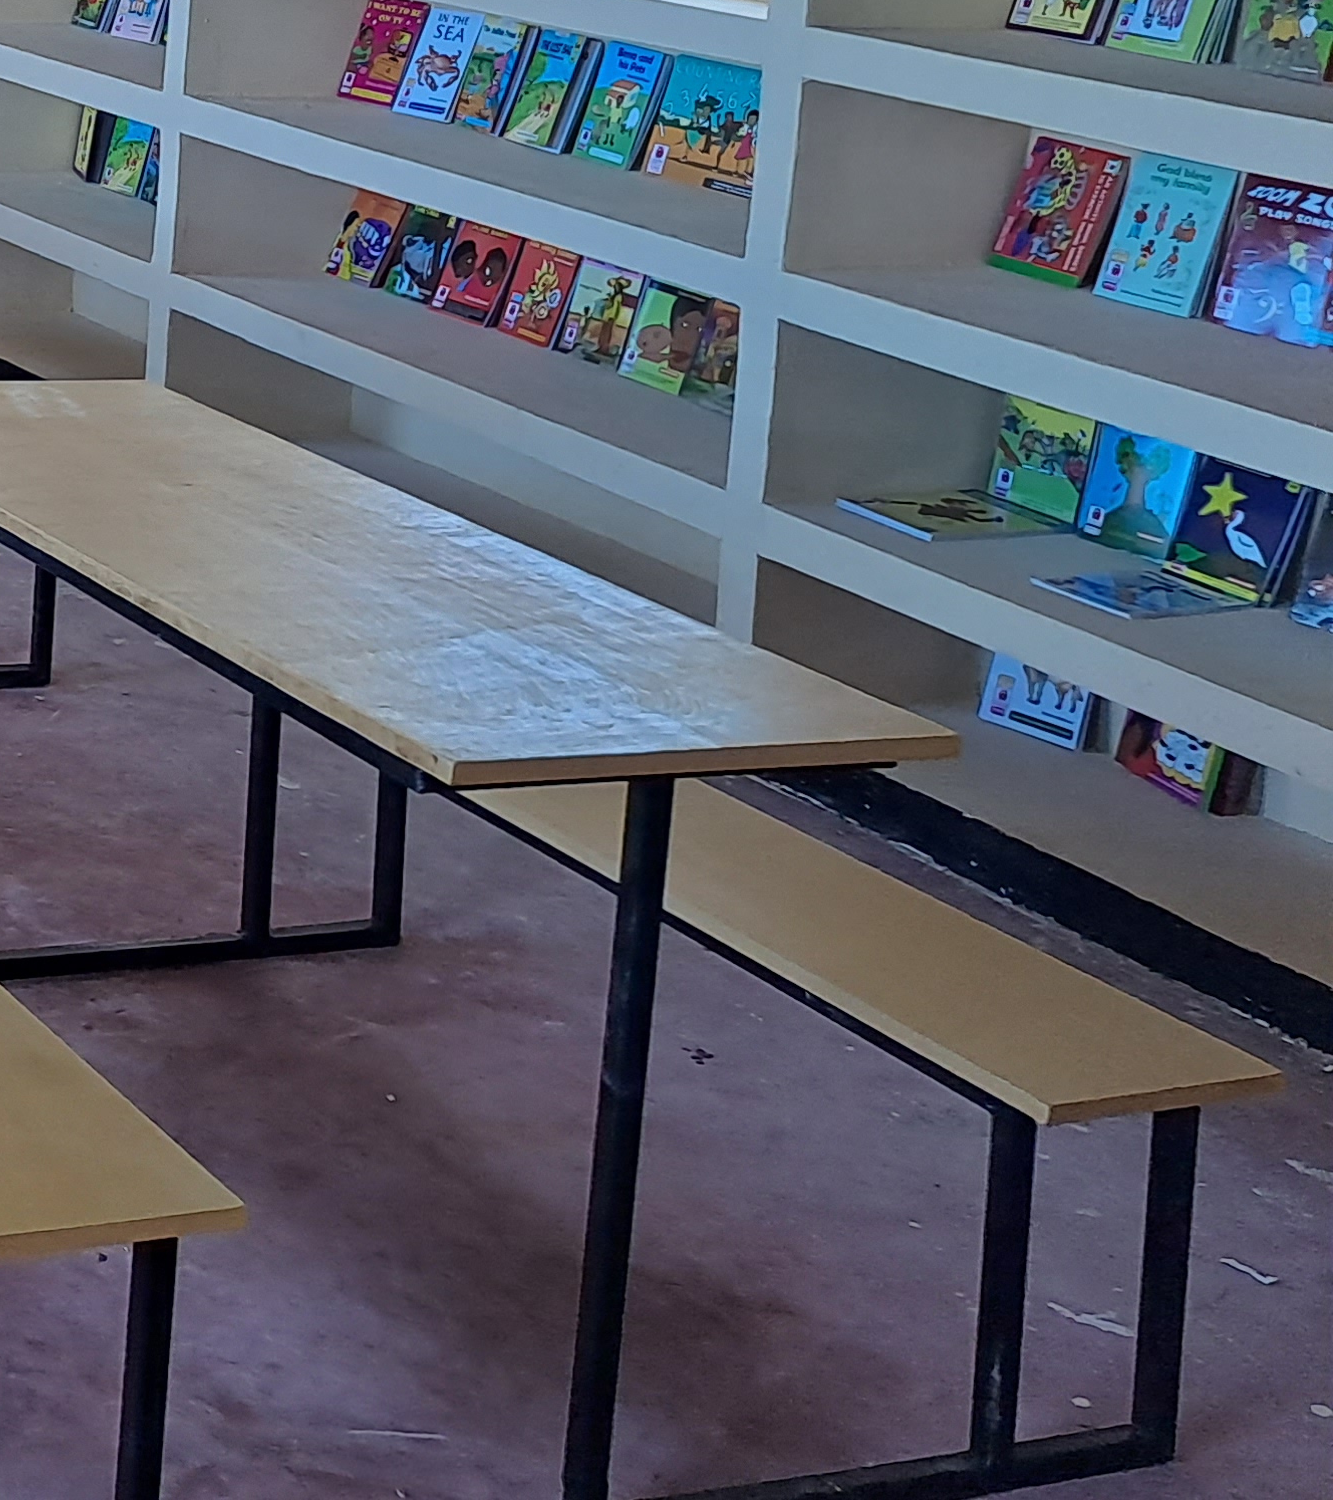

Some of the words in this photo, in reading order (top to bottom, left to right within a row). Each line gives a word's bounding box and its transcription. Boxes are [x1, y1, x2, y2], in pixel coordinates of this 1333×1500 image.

[373, 2, 398, 13] WANT
[398, 6, 410, 15] TO
[438, 13, 450, 23] IN
[452, 15, 470, 26] THE
[433, 23, 465, 43] SEA
[676, 62, 744, 85] COUNTING
[727, 93, 738, 109] 6
[1157, 164, 1181, 176] God
[1150, 175, 1169, 187] my
